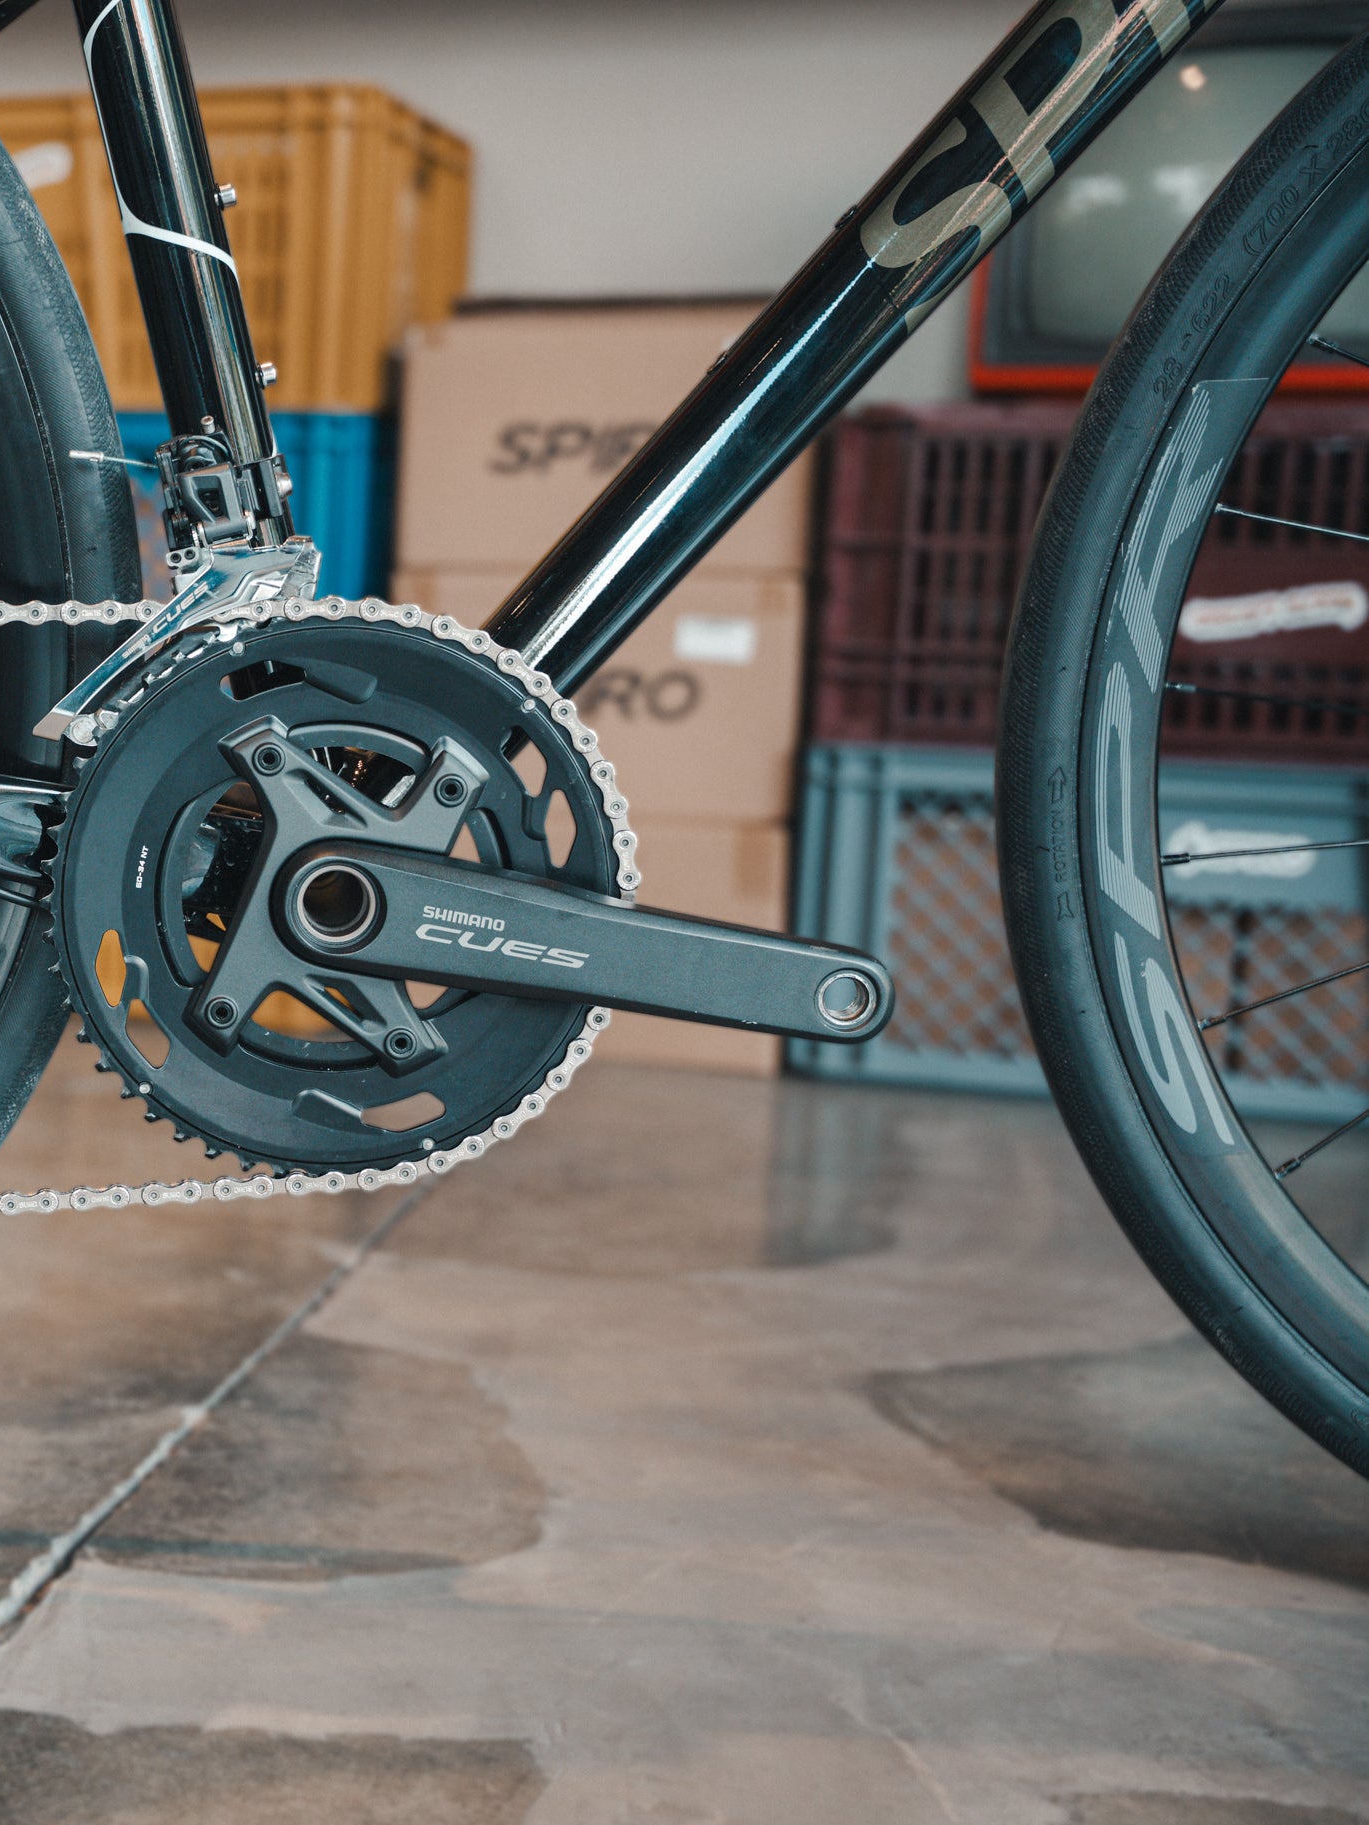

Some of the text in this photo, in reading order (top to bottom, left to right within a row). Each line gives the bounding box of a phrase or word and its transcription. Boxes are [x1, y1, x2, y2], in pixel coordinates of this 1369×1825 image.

[152, 581, 209, 634] CUES
[422, 905, 505, 932] SHIMANO
[415, 923, 590, 969] CUES
